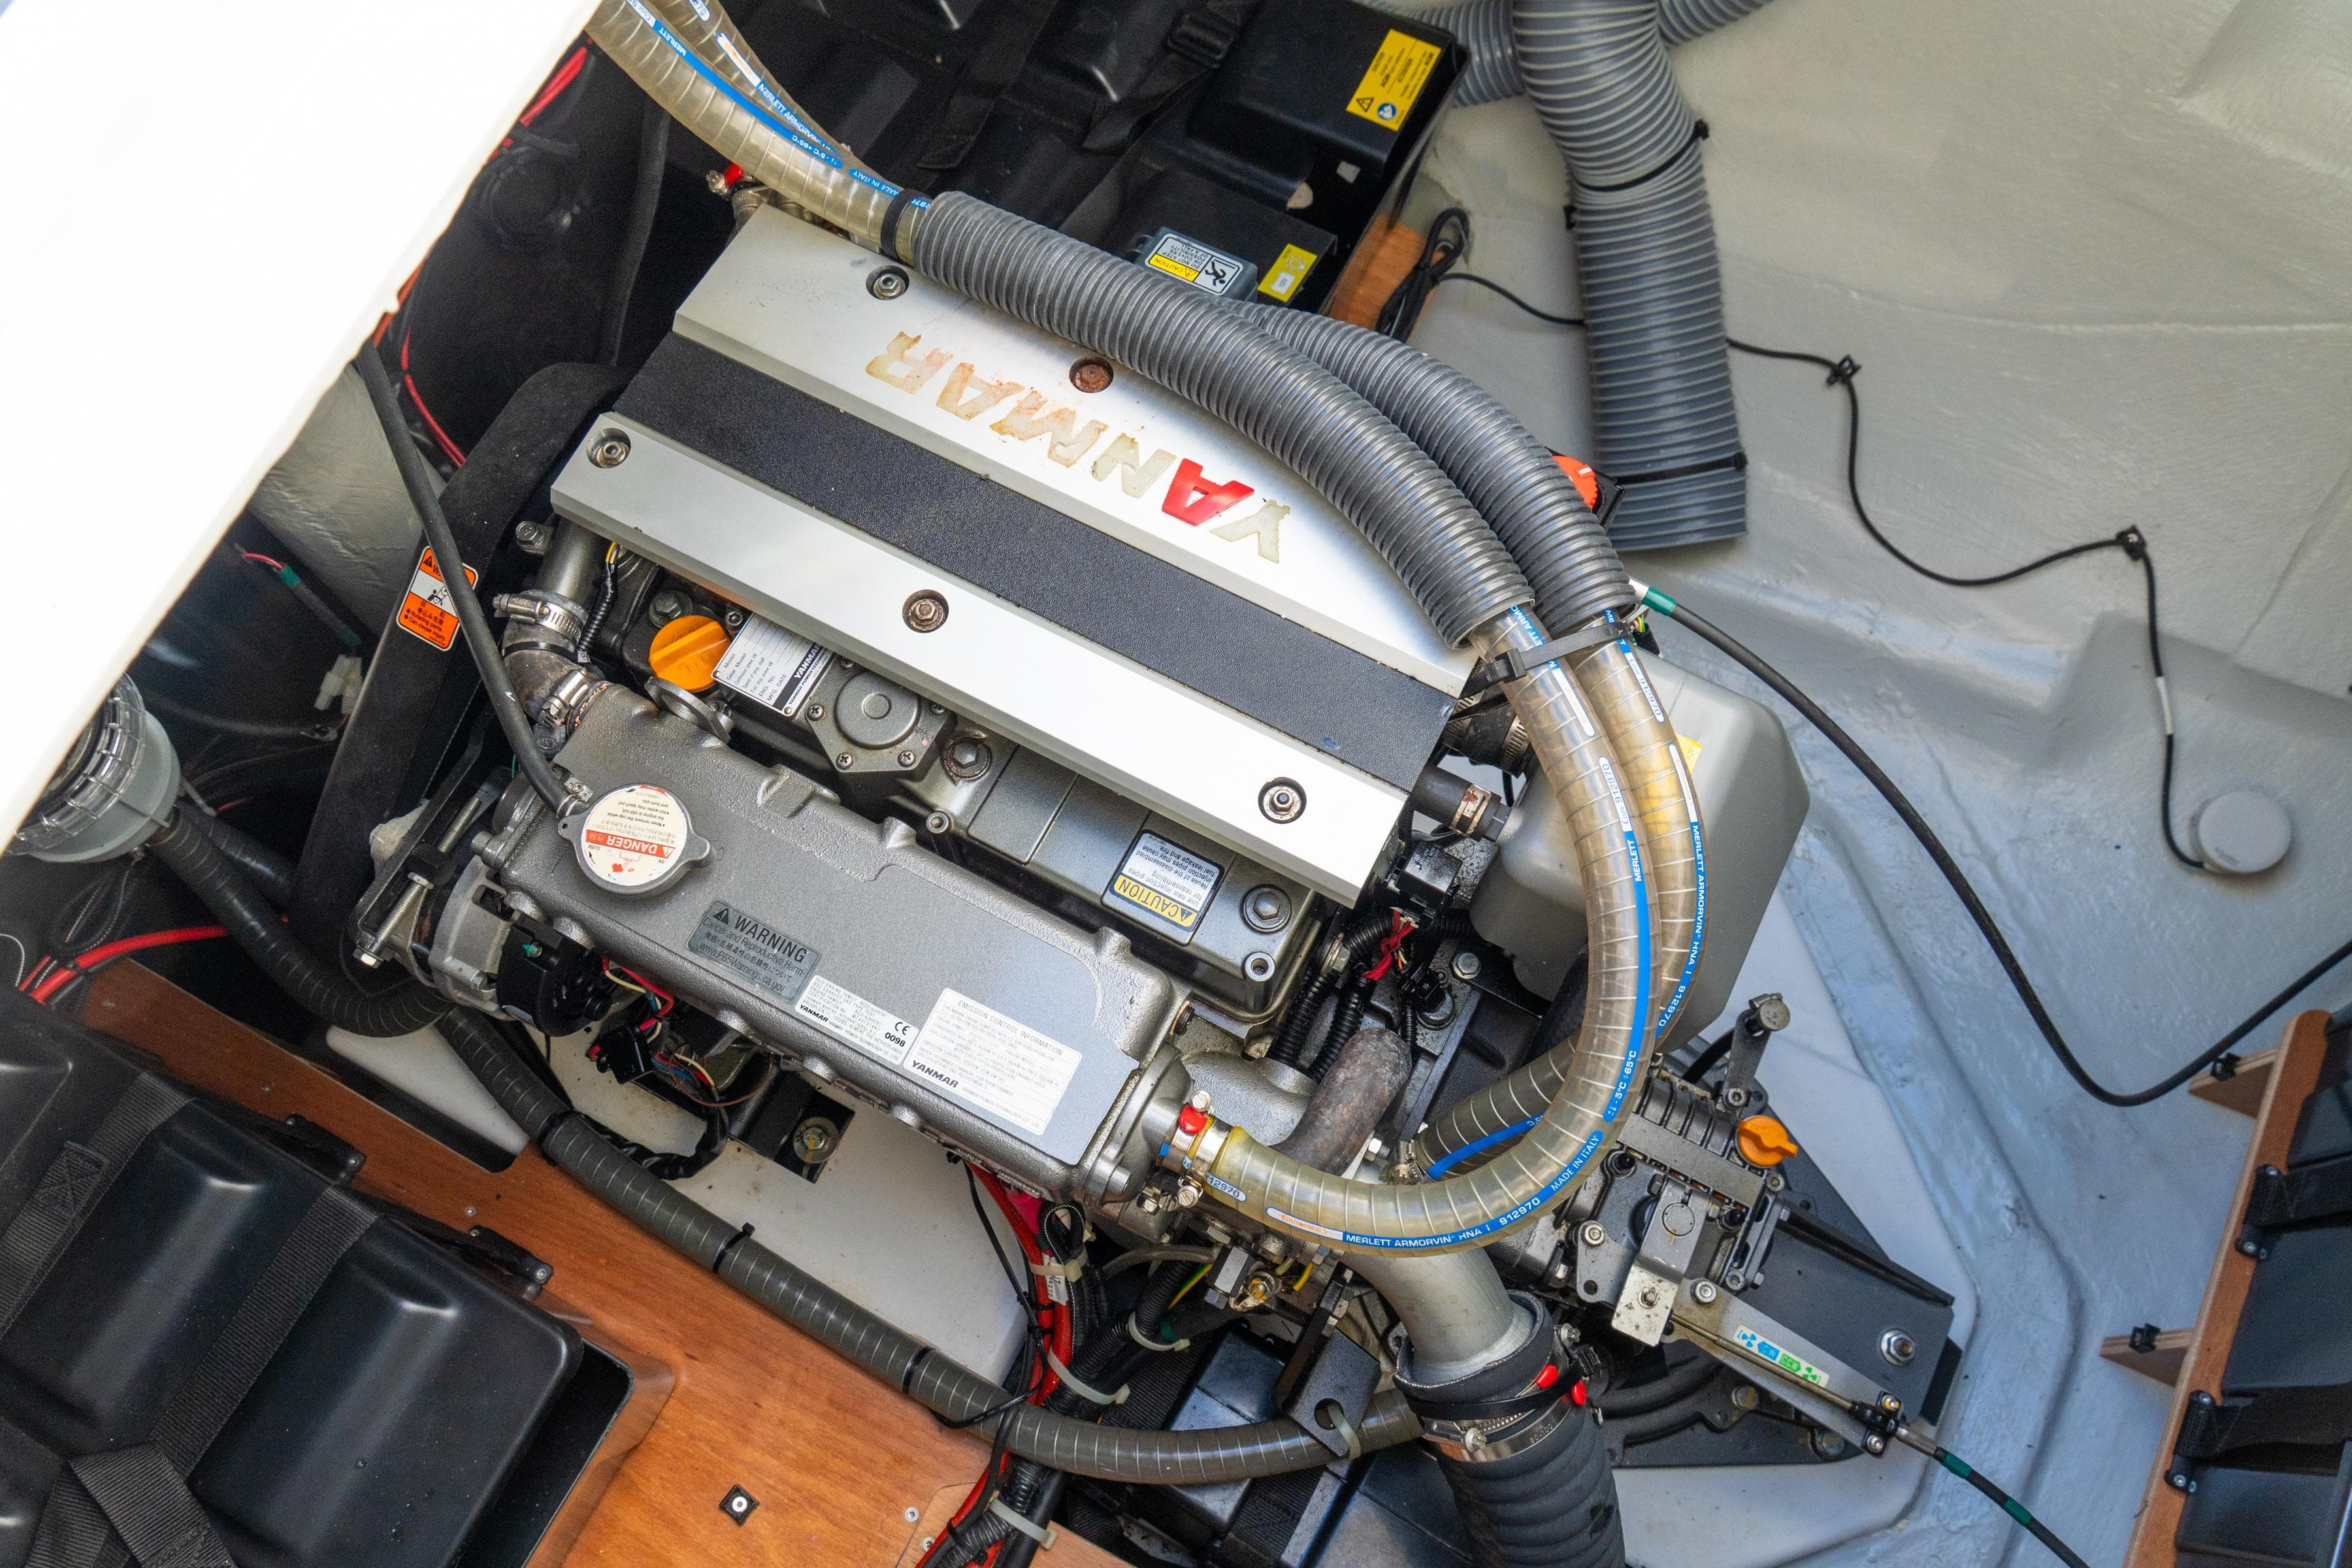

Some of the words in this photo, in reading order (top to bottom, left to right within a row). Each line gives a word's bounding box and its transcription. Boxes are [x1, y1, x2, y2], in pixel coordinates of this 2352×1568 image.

[657, 26, 686, 54] MERLETT
[757, 83, 787, 113] MERLETT
[851, 169, 871, 183] ITALY
[870, 178, 880, 188] IN
[1162, 250, 1177, 260] STEP
[1169, 248, 1193, 261] COVERS
[1170, 244, 1205, 262] POSSIBILITY
[1179, 243, 1194, 252] FALL
[1153, 257, 1183, 273] CAUTION
[1177, 257, 1190, 265] NOT
[865, 331, 1290, 563] YANMAR
[407, 616, 419, 626] Can
[417, 623, 433, 633] cause
[431, 629, 447, 642] injury.
[410, 610, 431, 626] Rotating
[429, 621, 444, 632] parts.
[723, 652, 736, 669] Model
[726, 668, 736, 681] Gear
[734, 651, 747, 668] Model
[734, 667, 748, 685] Continuous
[745, 657, 755, 669] power
[793, 642, 821, 680] YANMAR
[742, 677, 752, 689] Speed
[757, 656, 766, 666] shaft
[755, 676, 764, 685] stop
[760, 665, 771, 678] power
[758, 683, 770, 698] ENG.
[767, 673, 776, 683] No.
[766, 687, 778, 702] MFG.
[776, 672, 787, 687] DATE
[788, 685, 803, 705] YANMAR
[800, 669, 813, 686] POWER
[1639, 677, 1661, 716] 912970
[1601, 762, 1622, 804] 912970
[606, 835, 658, 855] DANGER
[1141, 844, 1159, 857] cause
[1157, 844, 1170, 855] fire.
[1169, 850, 1181, 860] and
[1692, 825, 1704, 872] MERLETT
[1135, 849, 1173, 873] disassembled
[1158, 852, 1173, 863] may
[1171, 858, 1188, 872] pipes
[1181, 855, 1204, 872] leakage
[1627, 838, 1642, 882] MERLETT
[1126, 866, 1145, 879] pipes
[1173, 868, 1183, 877] the
[1186, 867, 1212, 884] injection
[1203, 867, 1216, 877] fuel
[1144, 875, 1173, 894] injection
[1190, 877, 1208, 890] Reuse
[1117, 877, 1180, 919] CAUTION
[1171, 889, 1186, 900] new
[1186, 896, 1200, 907] Use
[1192, 892, 1202, 901] for
[702, 916, 728, 936] Cancer
[726, 930, 742, 943] and
[740, 936, 785, 966] Reproductive
[733, 915, 808, 963] WARNING
[703, 931, 793, 983] 発癌・生殖毒性の危険性について
[1686, 941, 1699, 966] HNA
[698, 941, 786, 994] www.P65Warnings.ca.gov
[825, 982, 842, 994] ENGINE
[1658, 983, 1686, 1027] 912970
[798, 1003, 828, 1023] YANMAR
[827, 1020, 843, 1032] YANMAR
[843, 1028, 858, 1039] POWER
[857, 1036, 883, 1052] TECHNOLOGY
[956, 999, 989, 1020] EMISSION
[988, 1015, 1019, 1034] CONTROL
[1019, 1030, 1064, 1056] INFORMATION
[883, 1031, 906, 1047] 0098
[910, 1060, 959, 1088] YANMAR
[1207, 1175, 1241, 1198] 12970
[1346, 1235, 1391, 1246] MERLETT
[1458, 1227, 1482, 1240] HNA
[1498, 1196, 1541, 1226] 912970
[1550, 1167, 1575, 1191] MADE
[1571, 1157, 1583, 1169] IN
[1580, 1135, 1600, 1158] ITALY
[1761, 1345, 1777, 1358] CW
